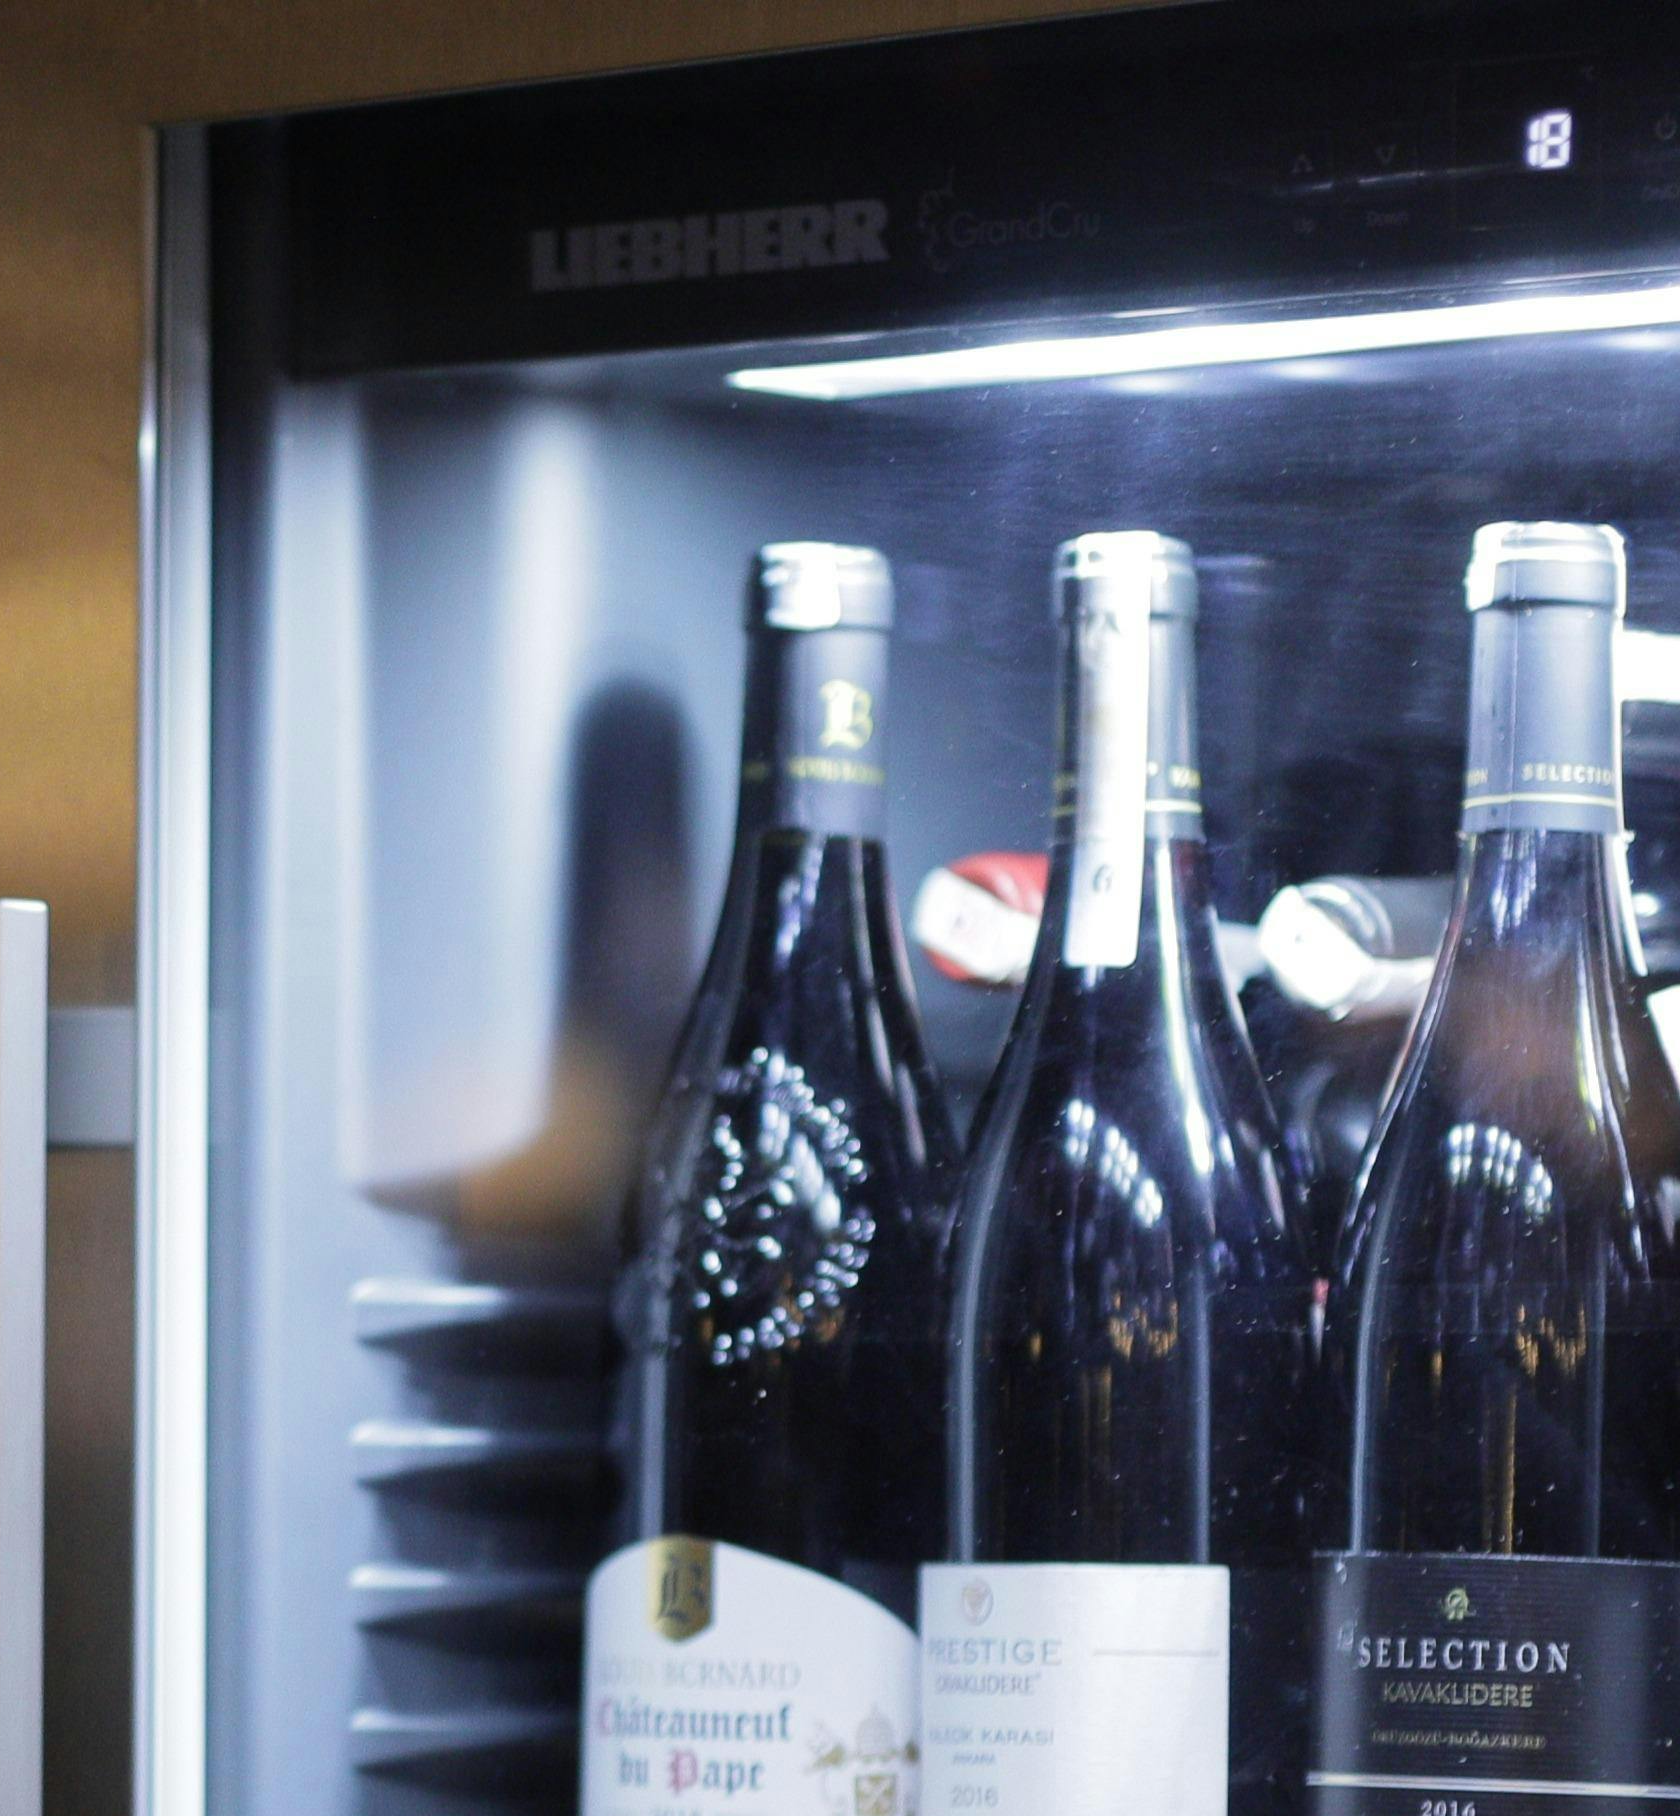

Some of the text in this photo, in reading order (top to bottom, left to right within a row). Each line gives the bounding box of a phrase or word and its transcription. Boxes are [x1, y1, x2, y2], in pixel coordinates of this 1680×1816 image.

[531, 199, 890, 291] LIEBHERR
[1521, 763, 1615, 786] SELECTIO
[1357, 1637, 1570, 1674] SELECTION
[1382, 1681, 1534, 1709] KAVAKLIDERE
[669, 1750, 765, 1796] Pape
